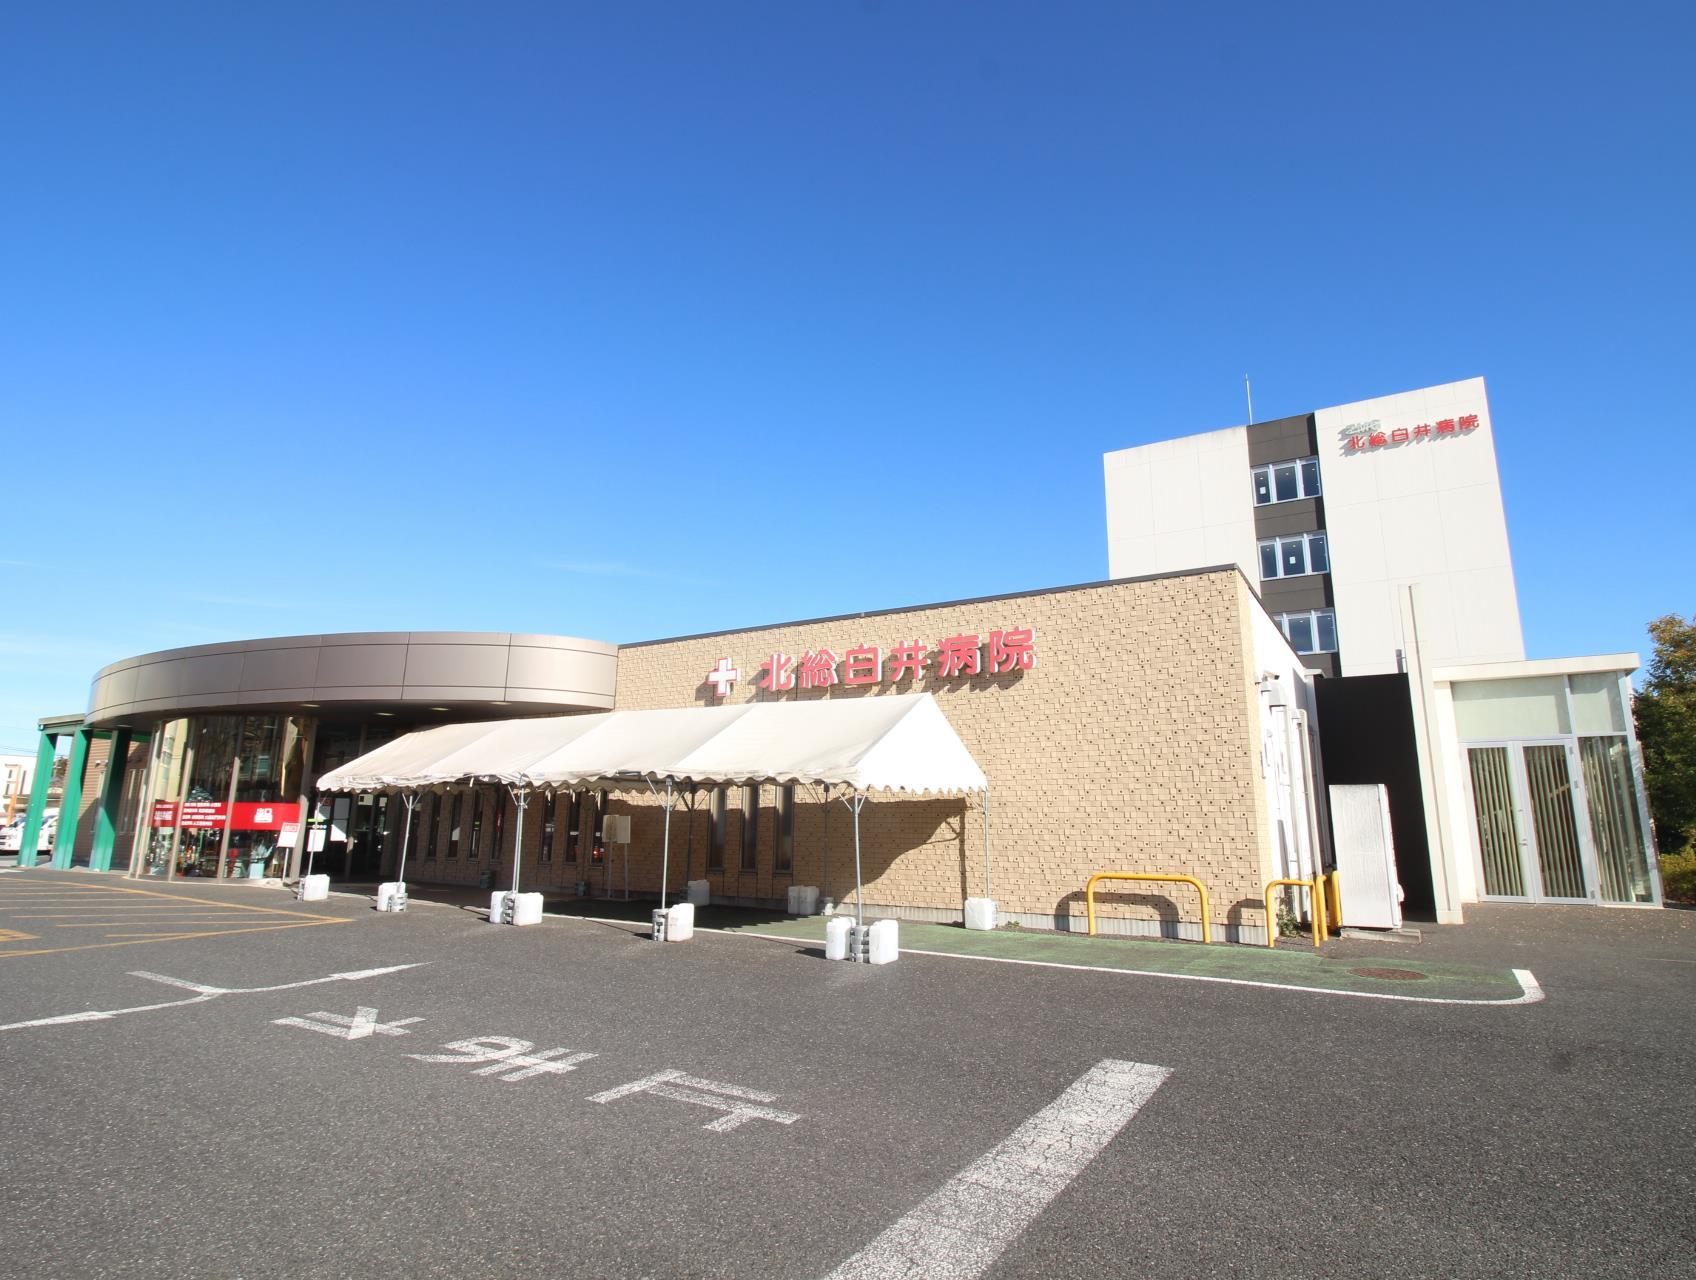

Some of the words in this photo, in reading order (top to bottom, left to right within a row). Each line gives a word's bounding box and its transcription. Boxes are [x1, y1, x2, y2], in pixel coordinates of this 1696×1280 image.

[1348, 414, 1480, 450] 北総白井病院
[759, 626, 1037, 692] 北総白井病院
[269, 1005, 800, 1132] 止まれ
